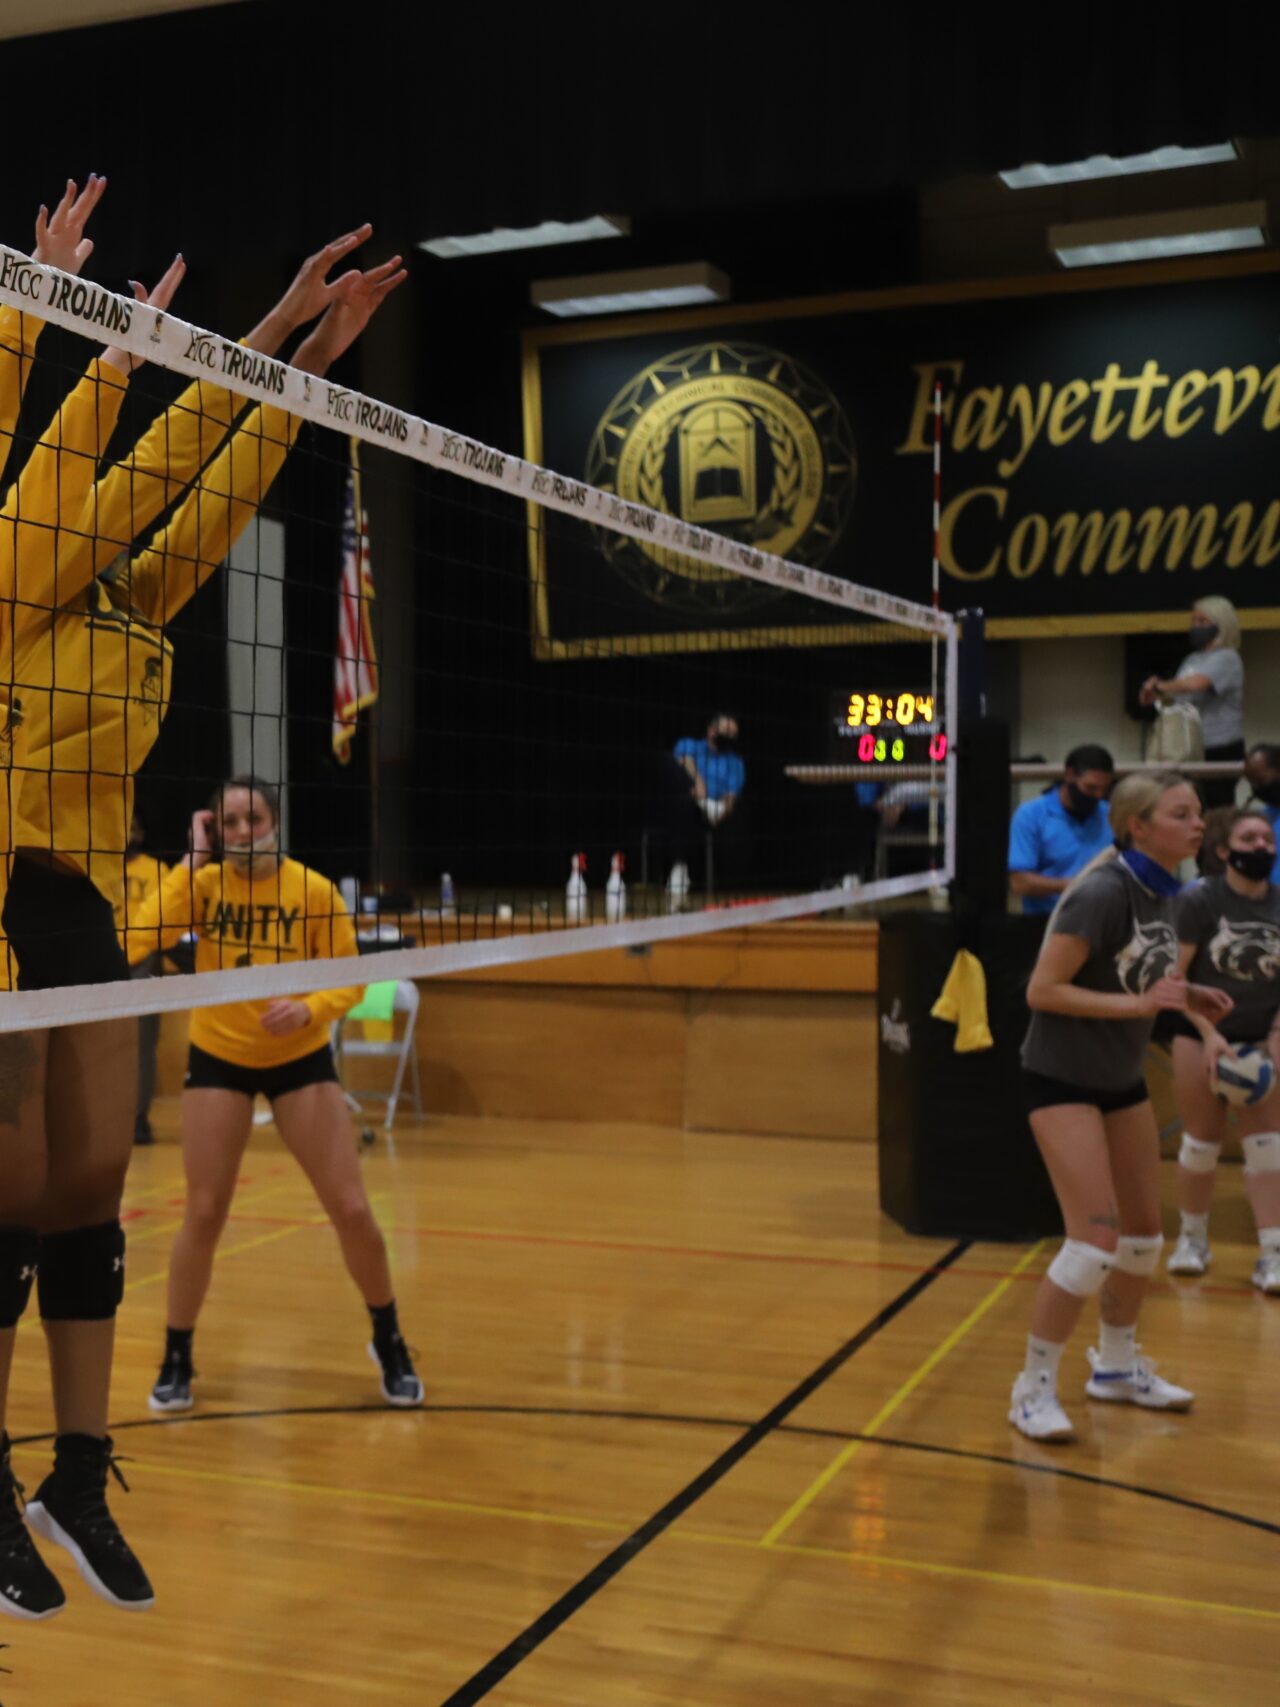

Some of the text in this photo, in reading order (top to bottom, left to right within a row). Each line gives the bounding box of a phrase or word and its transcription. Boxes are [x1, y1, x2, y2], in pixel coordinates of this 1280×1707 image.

[48, 274, 133, 335] TROJANS
[222, 344, 287, 395] TROJANS
[355, 399, 408, 442] TROJANS
[463, 441, 506, 478] TROJANS
[847, 693, 933, 726] 33:04
[200, 897, 300, 945] UNITY
